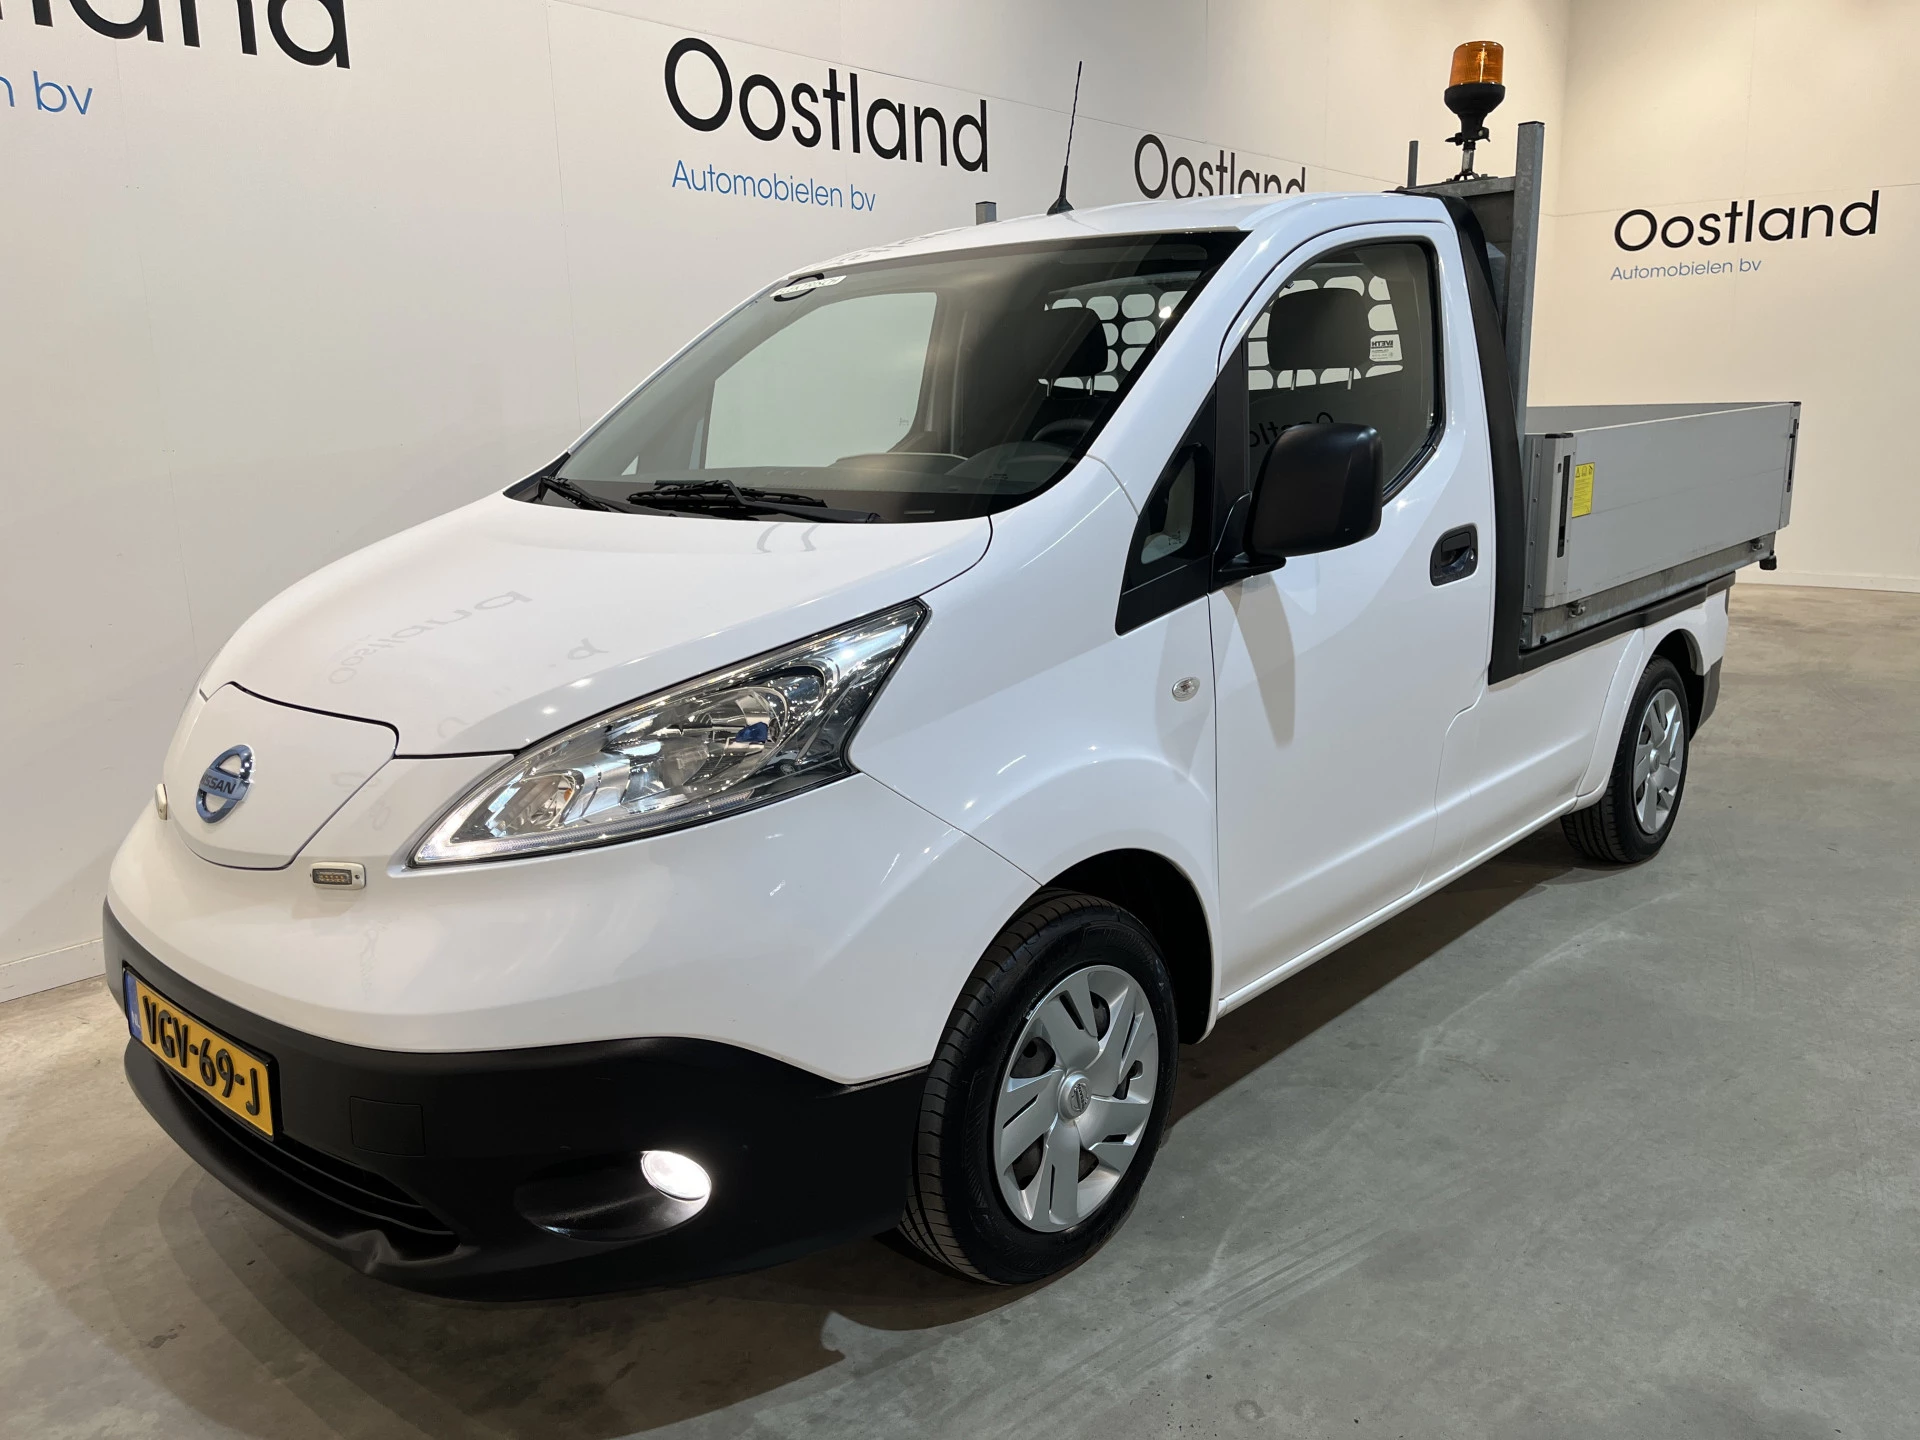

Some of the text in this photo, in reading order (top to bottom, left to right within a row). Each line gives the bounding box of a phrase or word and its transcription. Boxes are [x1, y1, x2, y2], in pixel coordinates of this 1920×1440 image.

[33, 70, 93, 115] bv
[664, 37, 988, 173] Oostland
[672, 159, 876, 212] Automobielen bv
[1614, 189, 1880, 252] Oostland
[1610, 258, 1762, 281] Automobielen bv
[142, 995, 261, 1116] VGV-69-J
